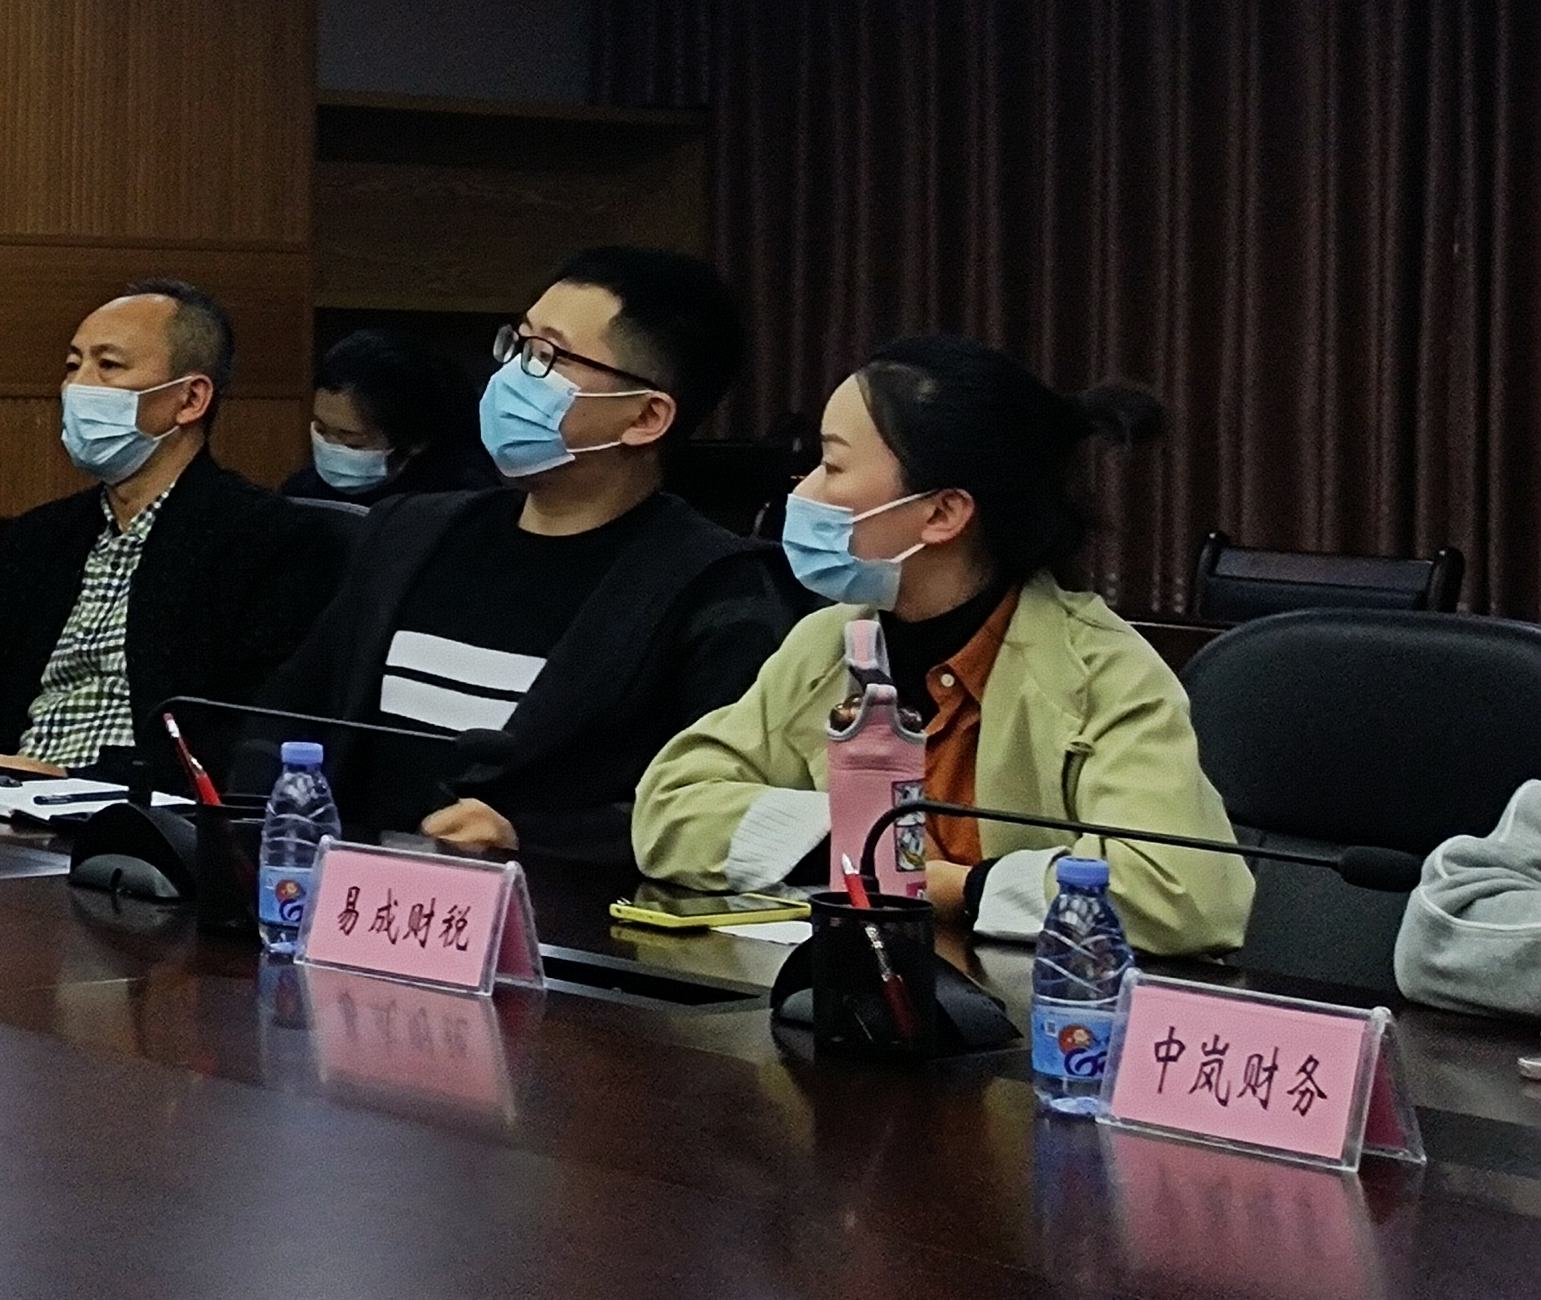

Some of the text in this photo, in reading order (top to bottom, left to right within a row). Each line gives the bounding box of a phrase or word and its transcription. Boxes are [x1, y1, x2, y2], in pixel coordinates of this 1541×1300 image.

[336, 885, 472, 951] 易成财税
[1152, 1025, 1328, 1117] 中岚财务
